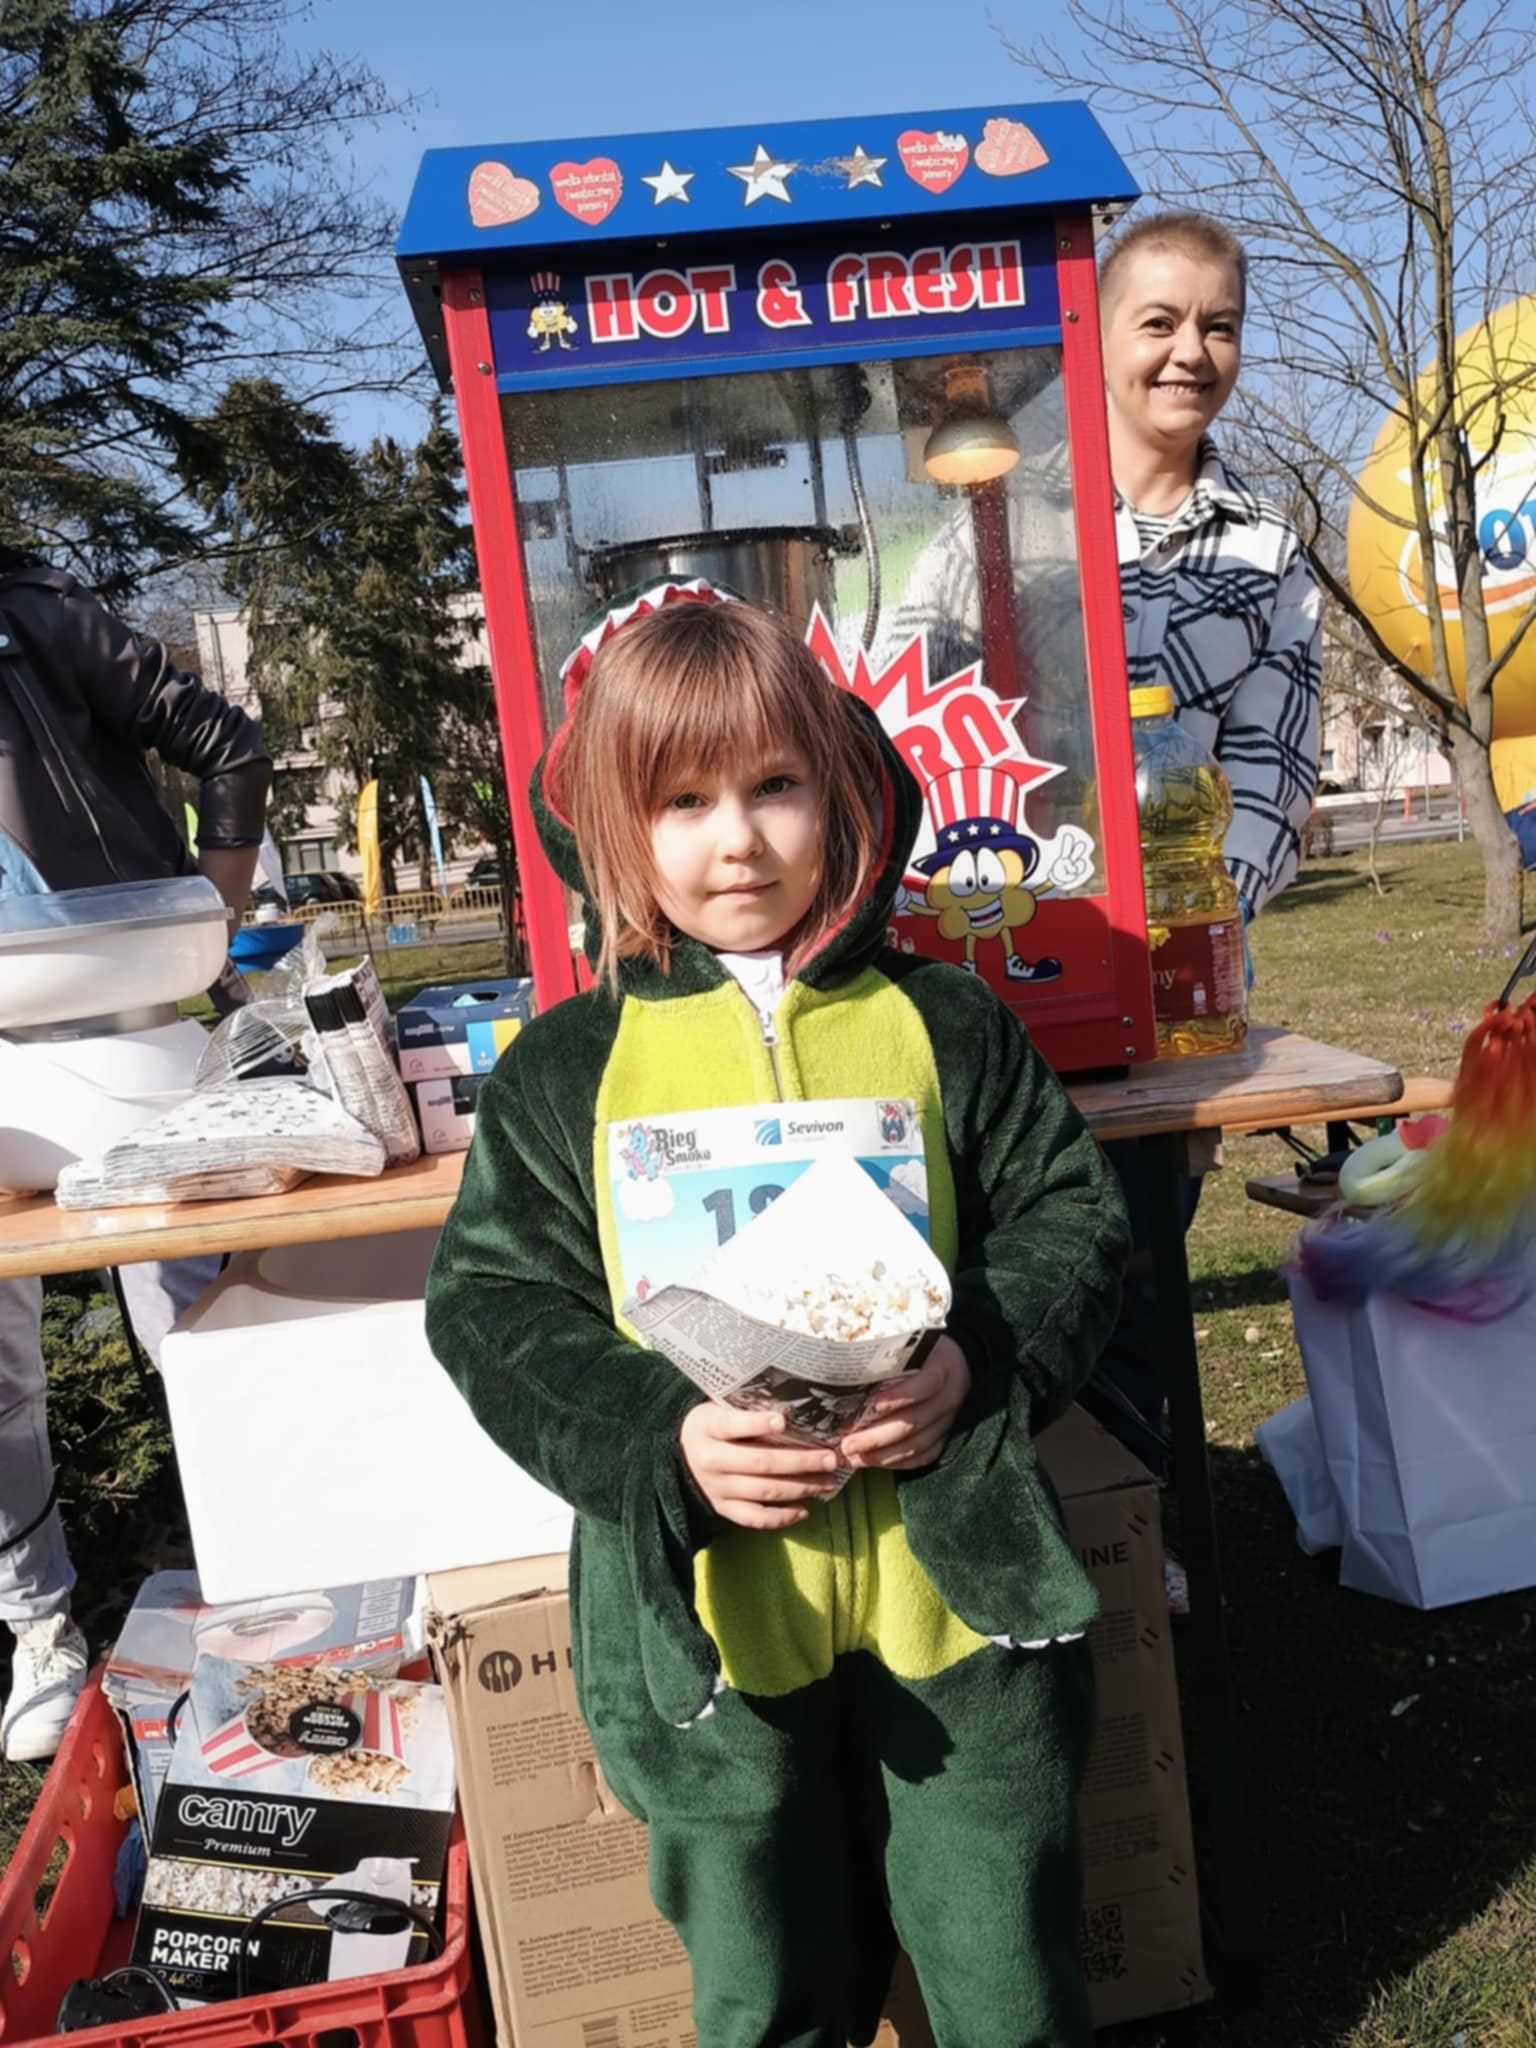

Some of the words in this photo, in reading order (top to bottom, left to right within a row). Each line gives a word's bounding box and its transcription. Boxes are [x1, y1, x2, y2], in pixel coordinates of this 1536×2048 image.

[584, 264, 737, 344] HOT
[756, 259, 813, 329] &
[827, 240, 1026, 323] FRESH
[652, 1127, 697, 1152] Bieg
[787, 1119, 845, 1136] Sevivon
[1081, 1540, 1128, 1569] INE
[178, 1793, 317, 1847] camry
[203, 1837, 272, 1857] Premium
[153, 1927, 261, 1958] POPCORN
[150, 1946, 230, 1972] MAKER
